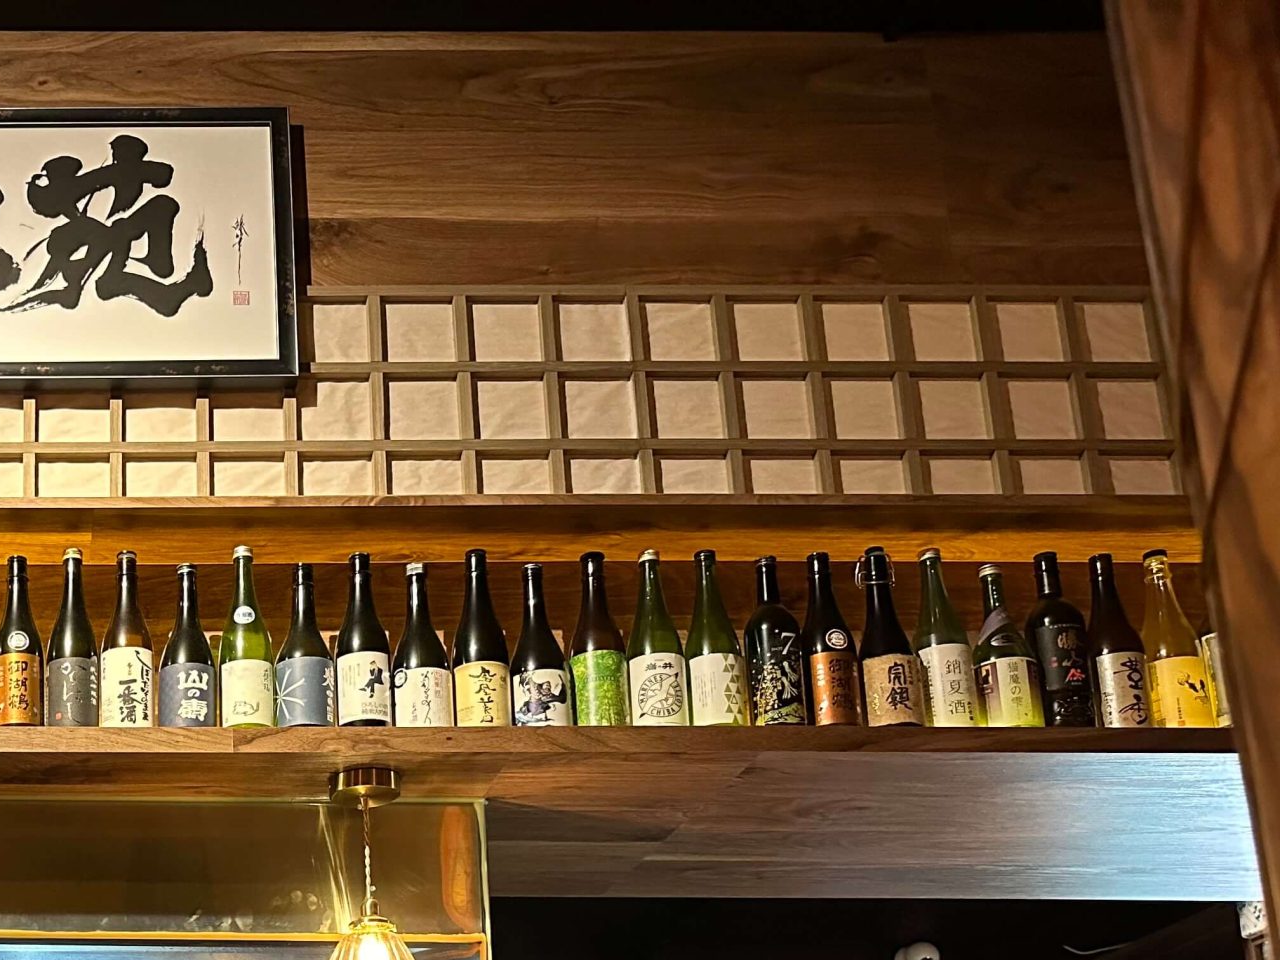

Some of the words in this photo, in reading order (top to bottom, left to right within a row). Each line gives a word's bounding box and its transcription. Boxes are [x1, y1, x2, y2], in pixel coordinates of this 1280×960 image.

[780, 632, 796, 655] 7
[8, 660, 29, 711] 御湖鶴
[639, 674, 663, 704] MARINES
[650, 707, 676, 716] CHIBA
